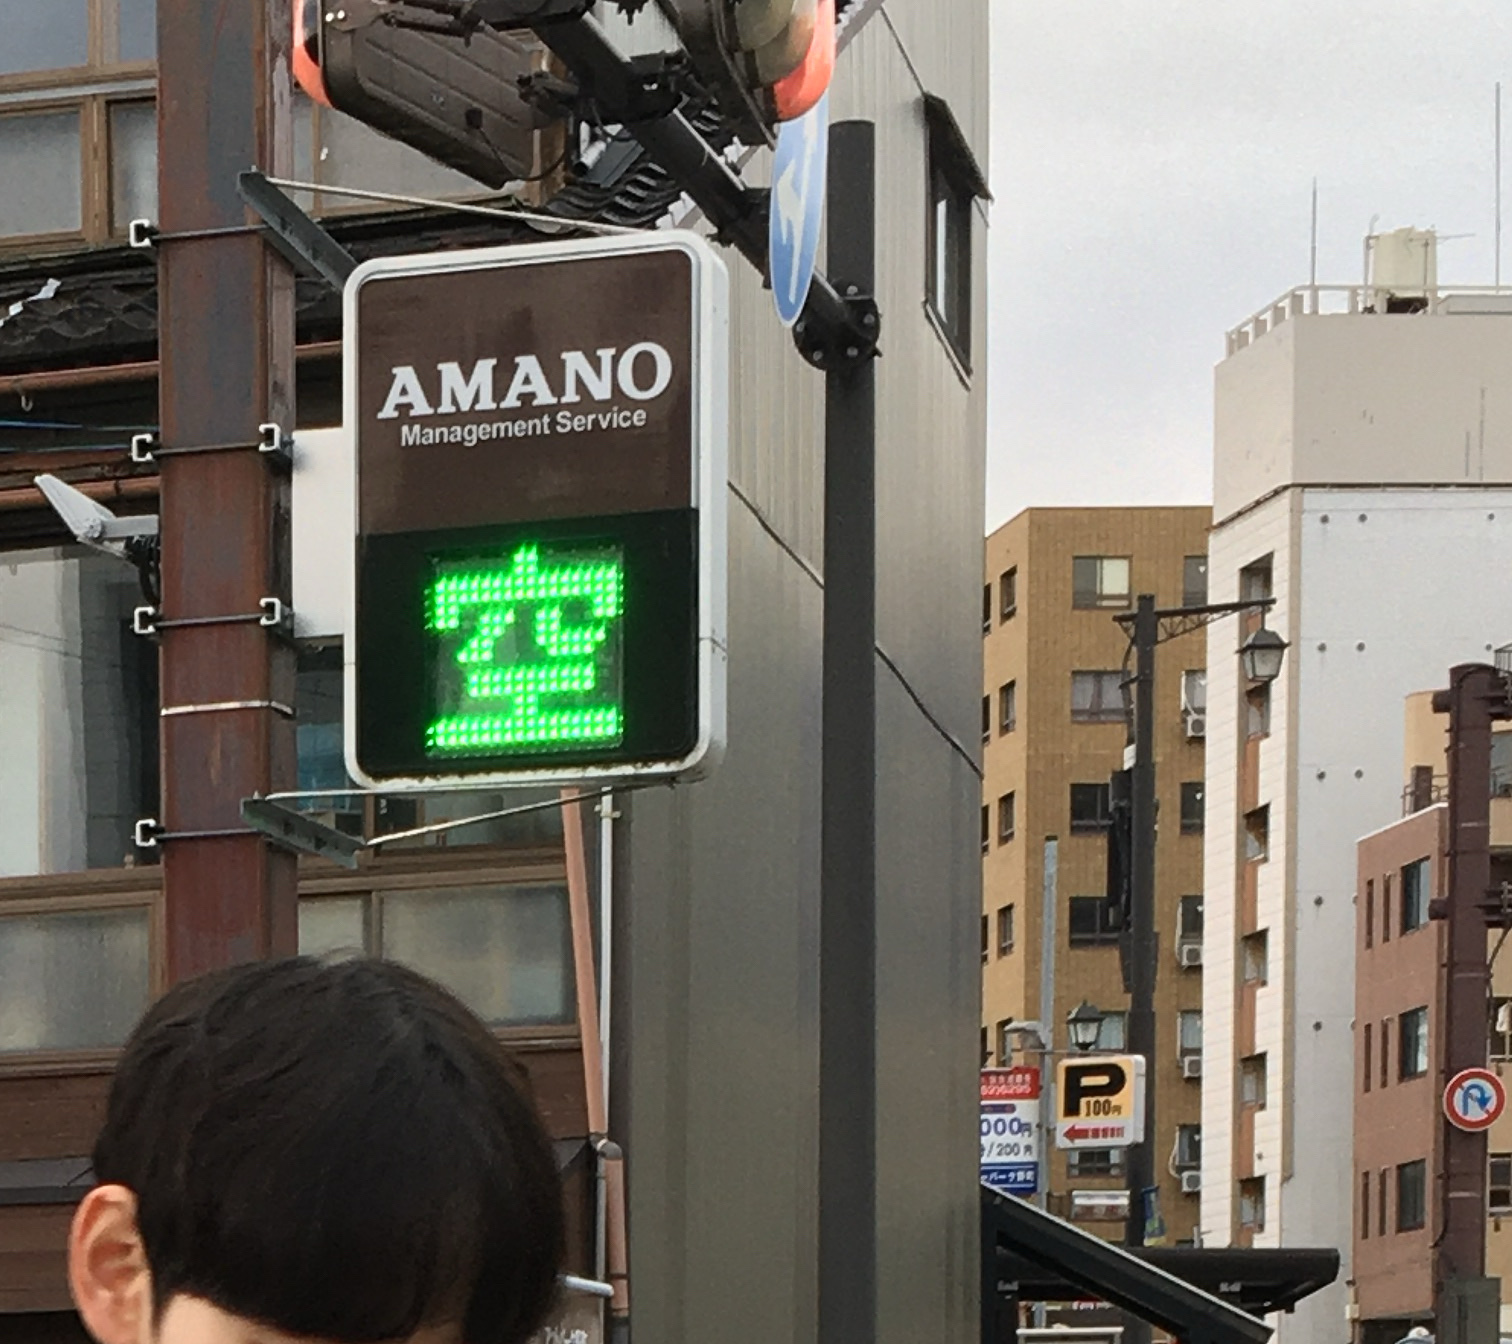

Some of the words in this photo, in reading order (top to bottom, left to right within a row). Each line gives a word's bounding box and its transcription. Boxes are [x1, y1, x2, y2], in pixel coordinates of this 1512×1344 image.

[377, 341, 672, 419] AMANO
[400, 414, 551, 449] Management
[555, 406, 648, 432] Service
[425, 543, 623, 749] 空
[1063, 1063, 1127, 1117] P
